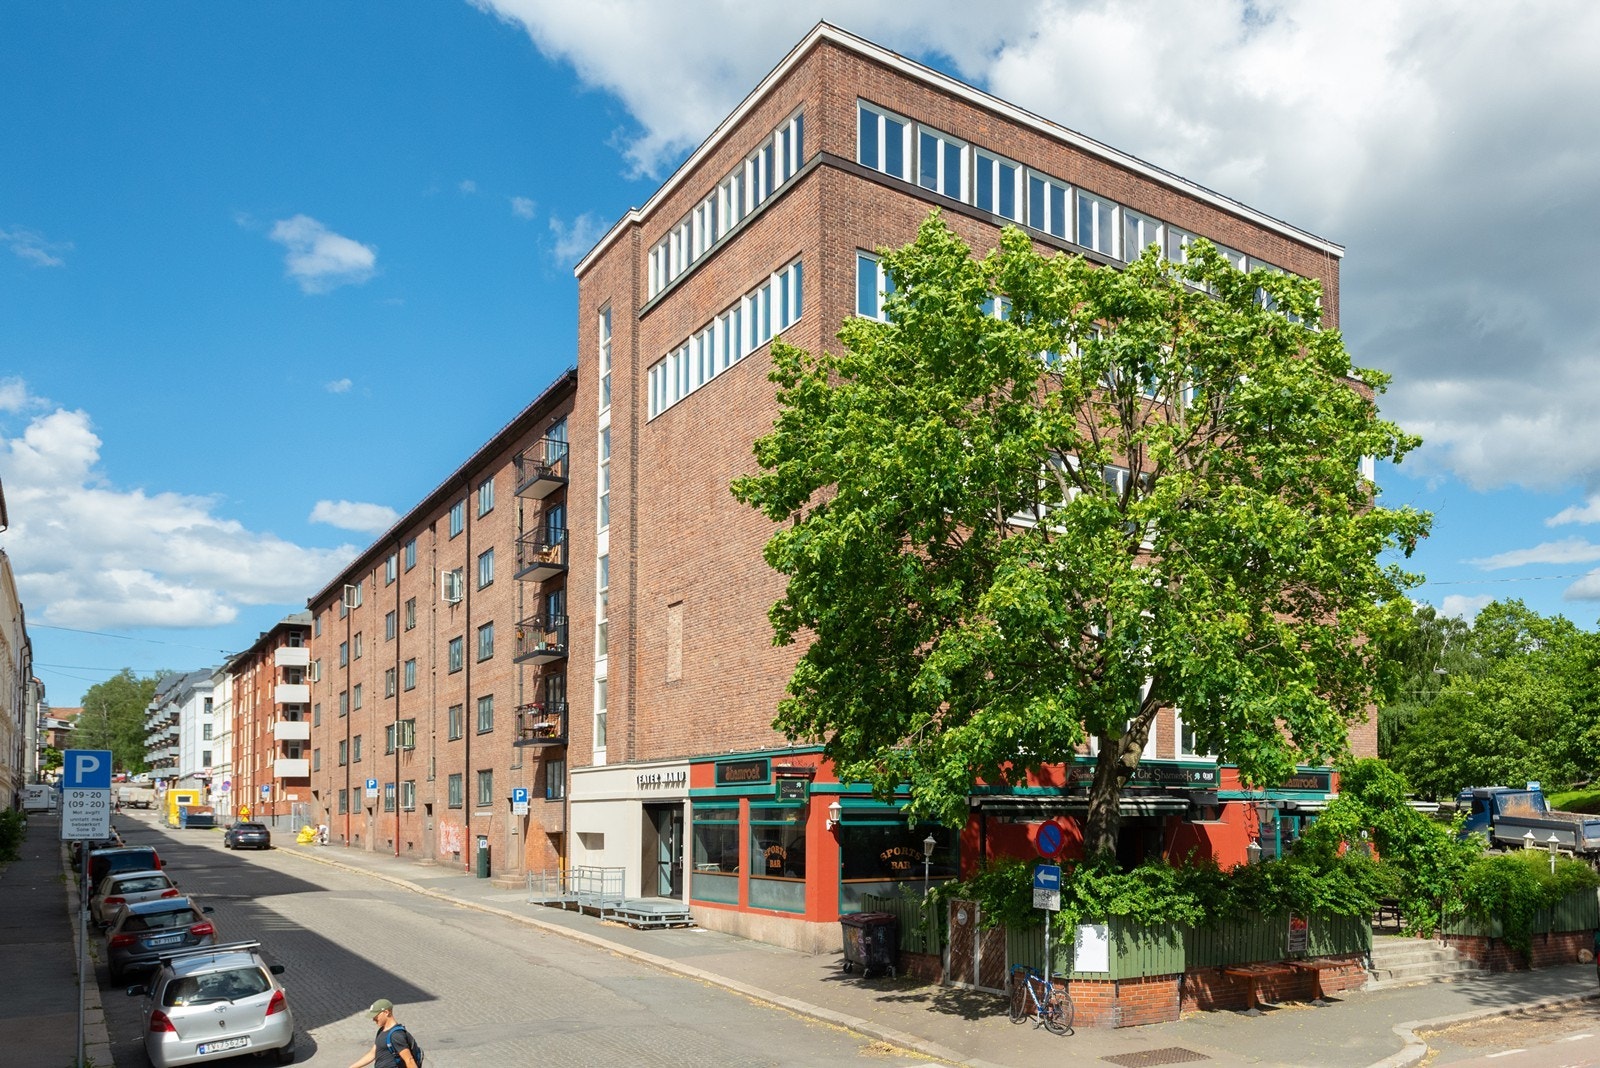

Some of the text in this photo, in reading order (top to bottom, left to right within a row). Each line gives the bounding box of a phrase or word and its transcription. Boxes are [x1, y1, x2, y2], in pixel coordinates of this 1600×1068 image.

[76, 755, 100, 784] P
[725, 764, 761, 781] Shamrock
[1137, 768, 1152, 780] The
[1154, 768, 1193, 782] Shamrock
[1281, 776, 1318, 788] amrock
[516, 790, 524, 801] P
[764, 846, 788, 860] SPORTS
[880, 846, 922, 861] SPORTS
[770, 860, 782, 868] BAR
[891, 861, 912, 870] BAR
